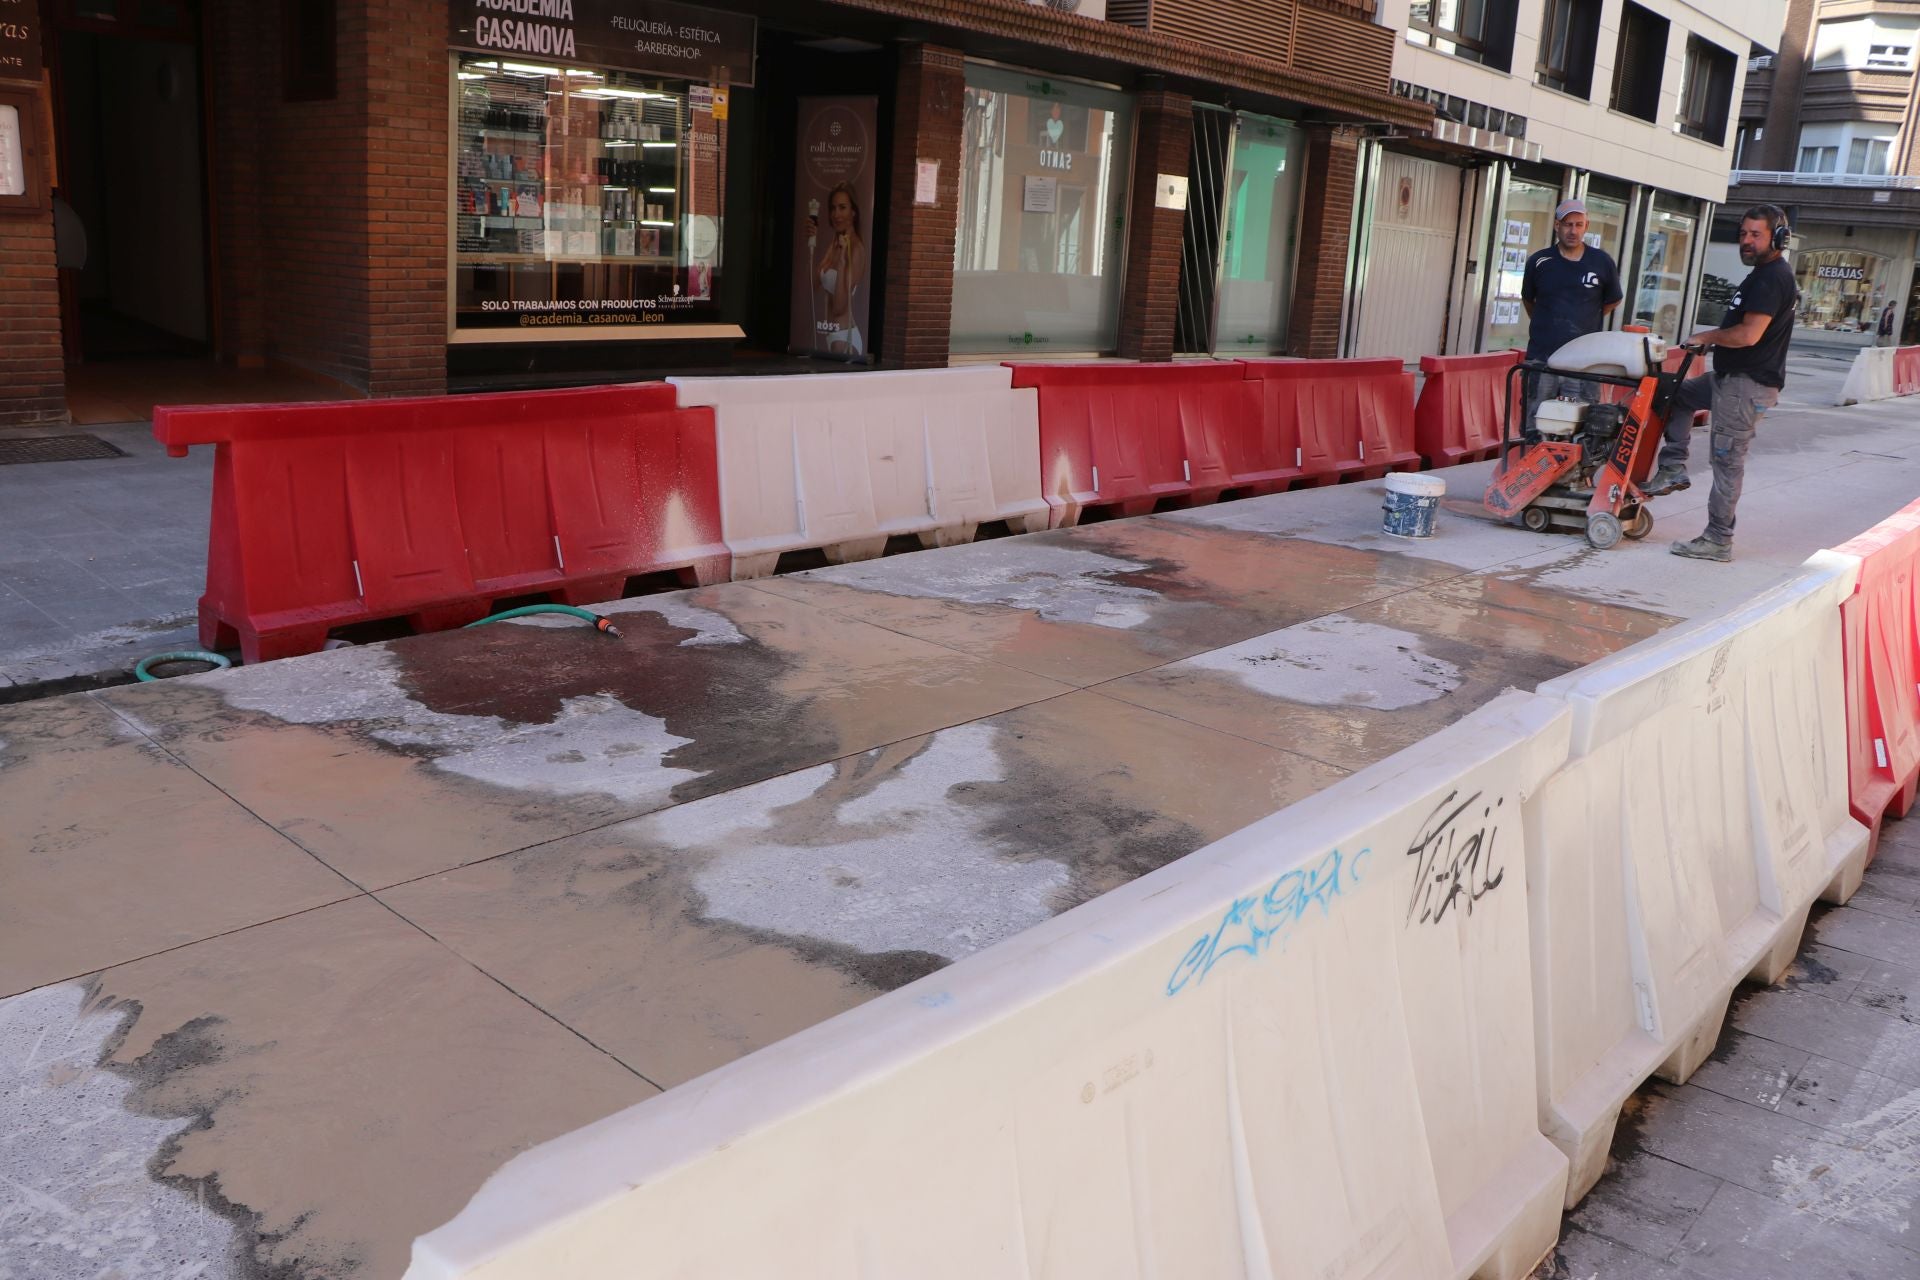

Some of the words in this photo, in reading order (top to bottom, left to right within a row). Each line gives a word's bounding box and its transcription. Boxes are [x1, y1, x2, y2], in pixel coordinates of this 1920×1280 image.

[476, 0, 574, 20] EMIA
[475, 15, 576, 58] CASANOVA
[680, 25, 721, 43] ESTÉTICA
[681, 131, 718, 143] HORARIO
[810, 141, 826, 153] roll
[827, 142, 862, 155] Systemic
[1818, 266, 1864, 280] REBAJAS
[481, 300, 510, 311] SOLO
[512, 300, 576, 311] TRABAJAMOS
[578, 300, 598, 310] CON
[601, 299, 657, 310] PRODUCTOS
[657, 294, 695, 305] Schwarzkopf
[519, 311, 665, 327] @academia_casanova_leon
[1616, 425, 1637, 465] FS170
